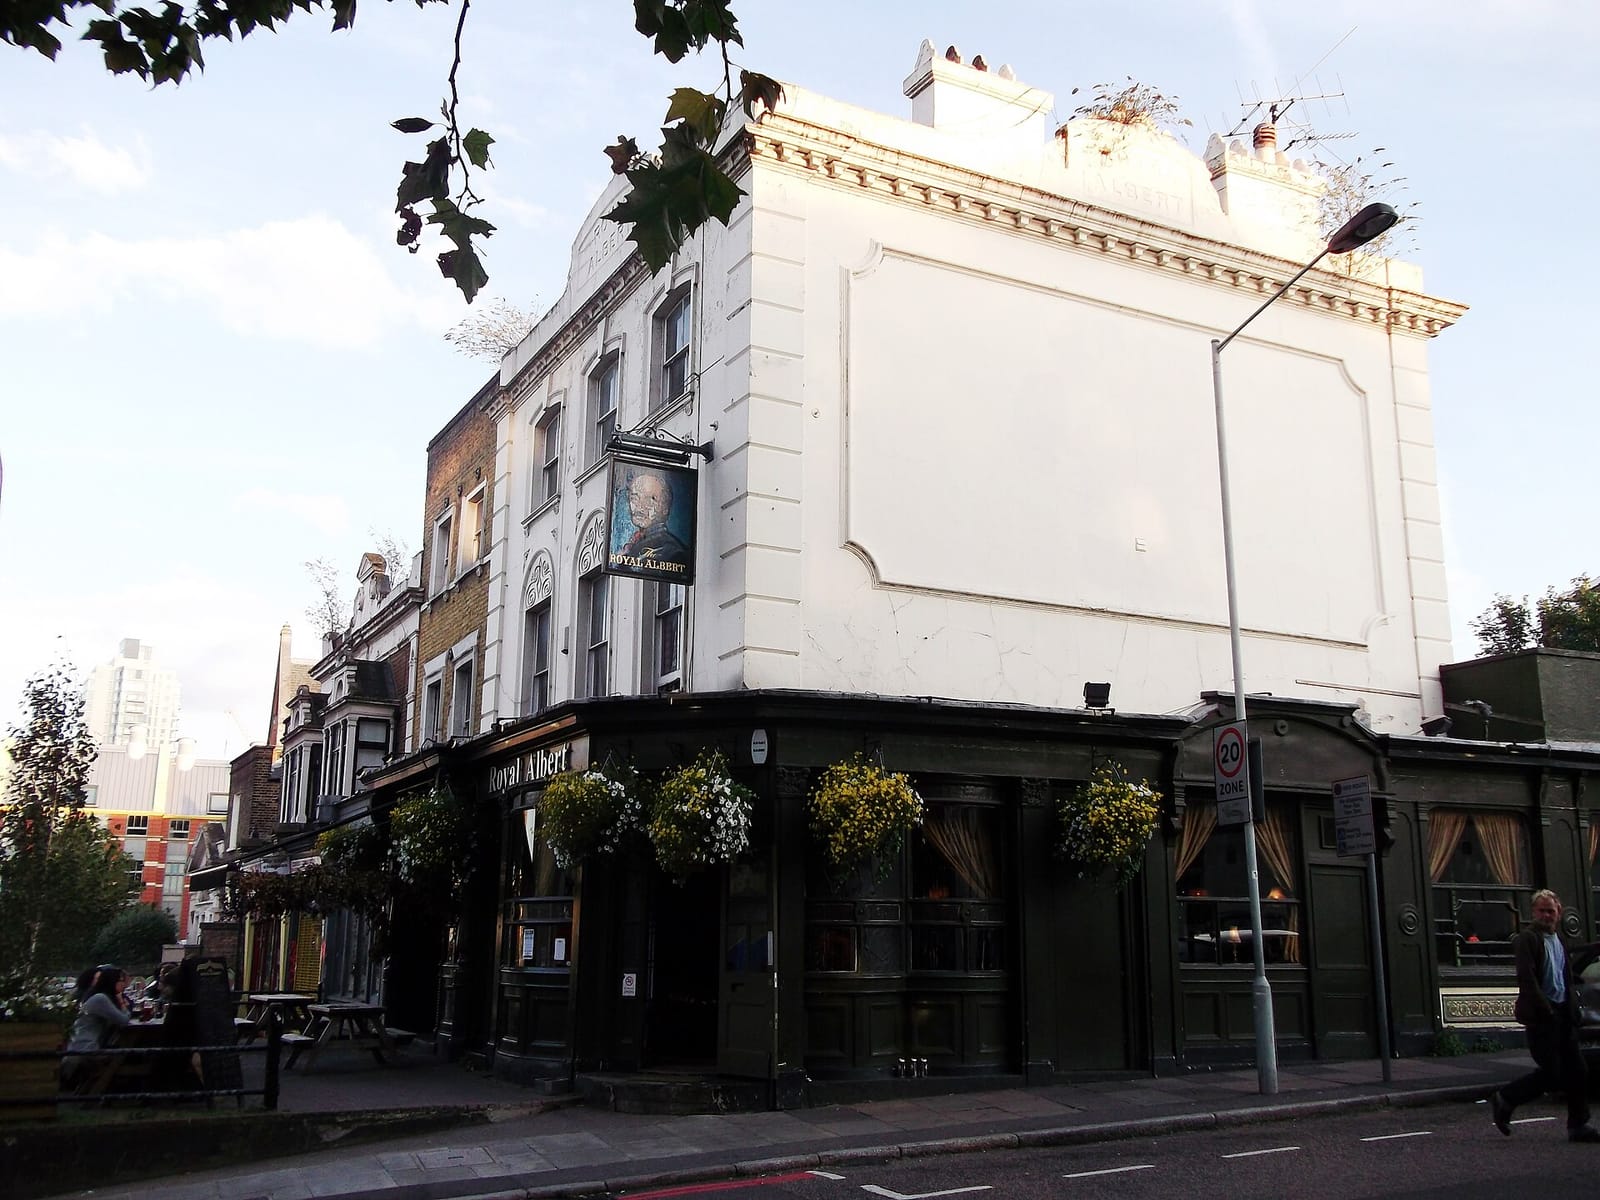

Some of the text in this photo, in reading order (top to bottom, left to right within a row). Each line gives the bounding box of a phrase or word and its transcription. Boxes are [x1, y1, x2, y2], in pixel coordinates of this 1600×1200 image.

[1087, 172, 1183, 214] ALBERT
[610, 554, 686, 572] ROYAL ALBERT
[1220, 742, 1240, 764] 20
[489, 742, 570, 794] Royal Albert
[1219, 780, 1244, 795] ZONE
